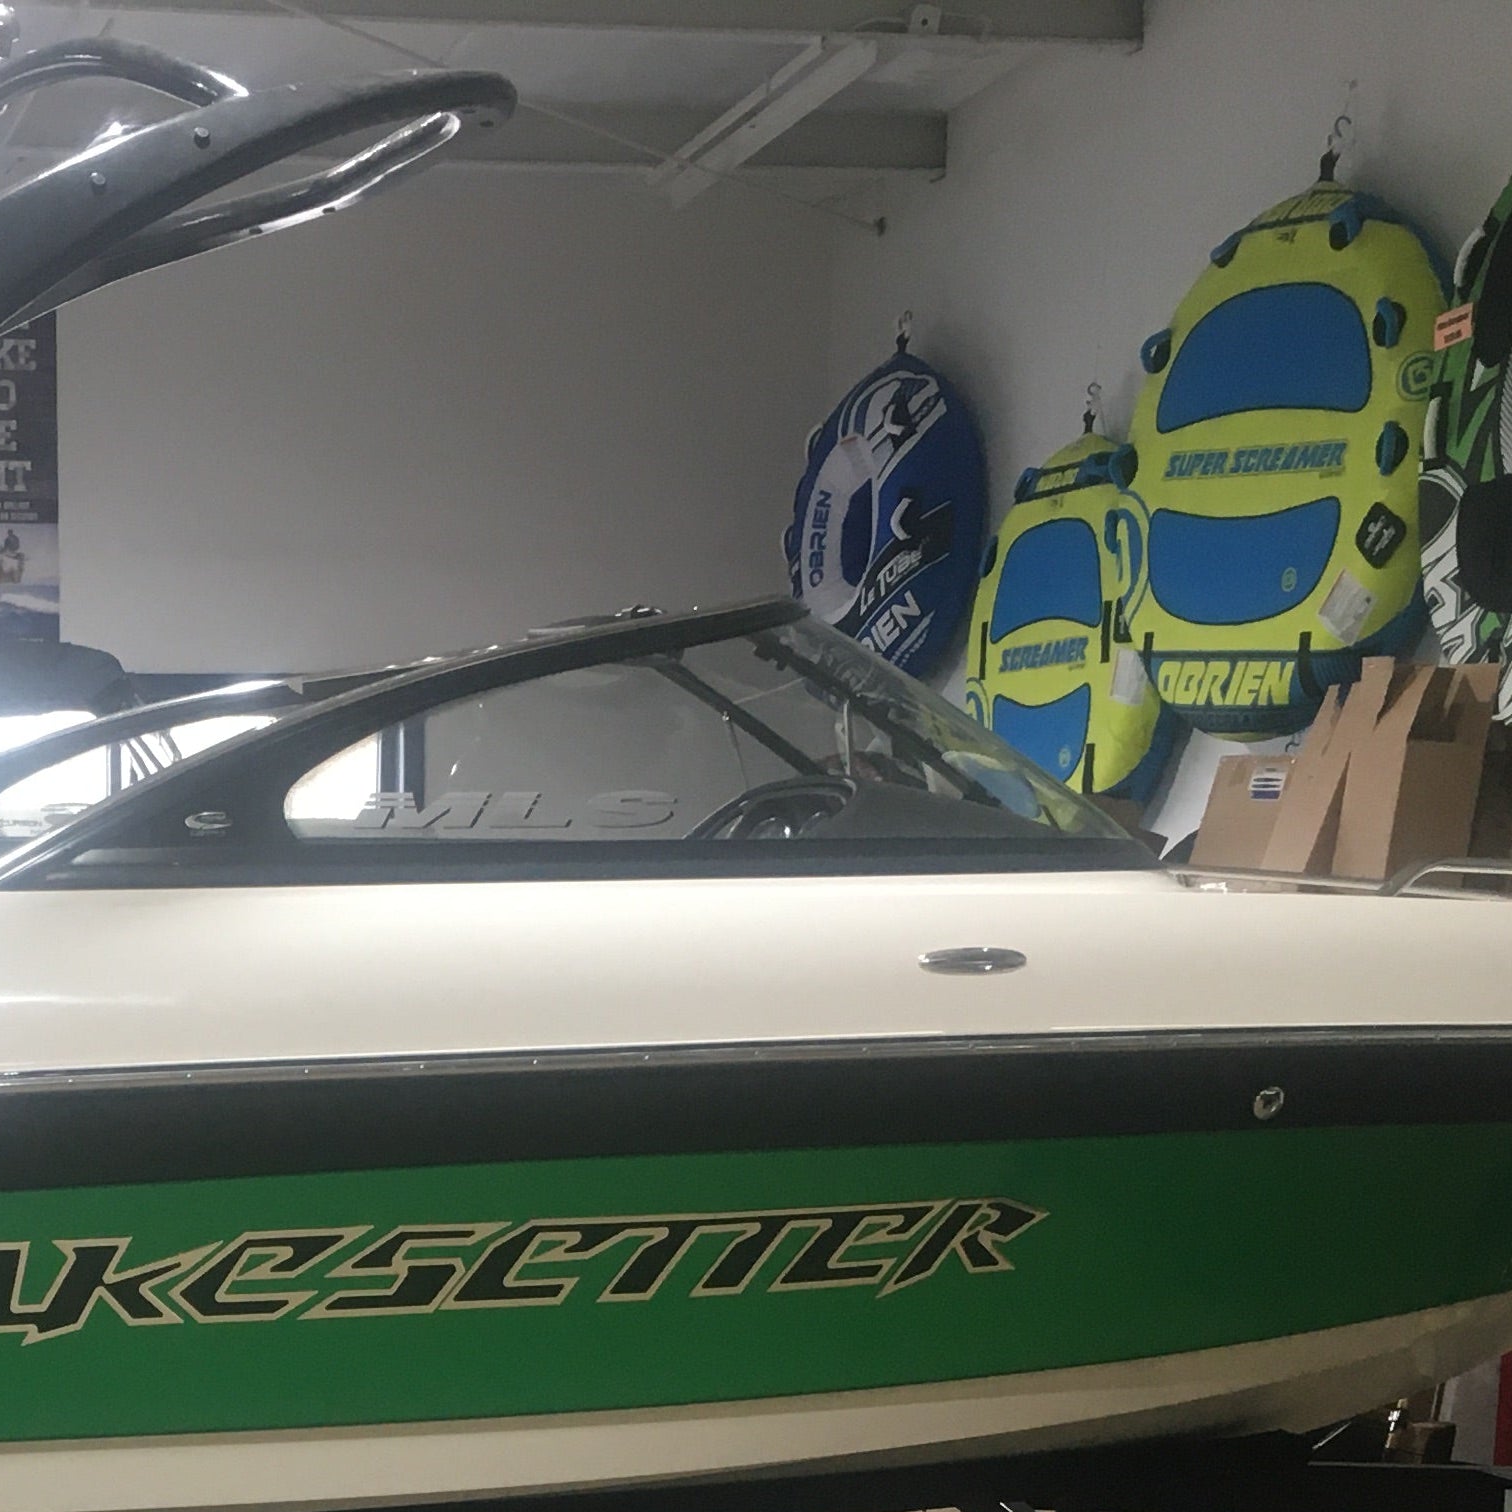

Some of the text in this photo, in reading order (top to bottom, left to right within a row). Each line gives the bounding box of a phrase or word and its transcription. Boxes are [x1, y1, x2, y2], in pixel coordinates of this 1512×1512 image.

[1163, 441, 1348, 478] SUPER SCREAMER
[999, 636, 1088, 673] SCREAMER
[1158, 661, 1295, 706] OBRIEN
